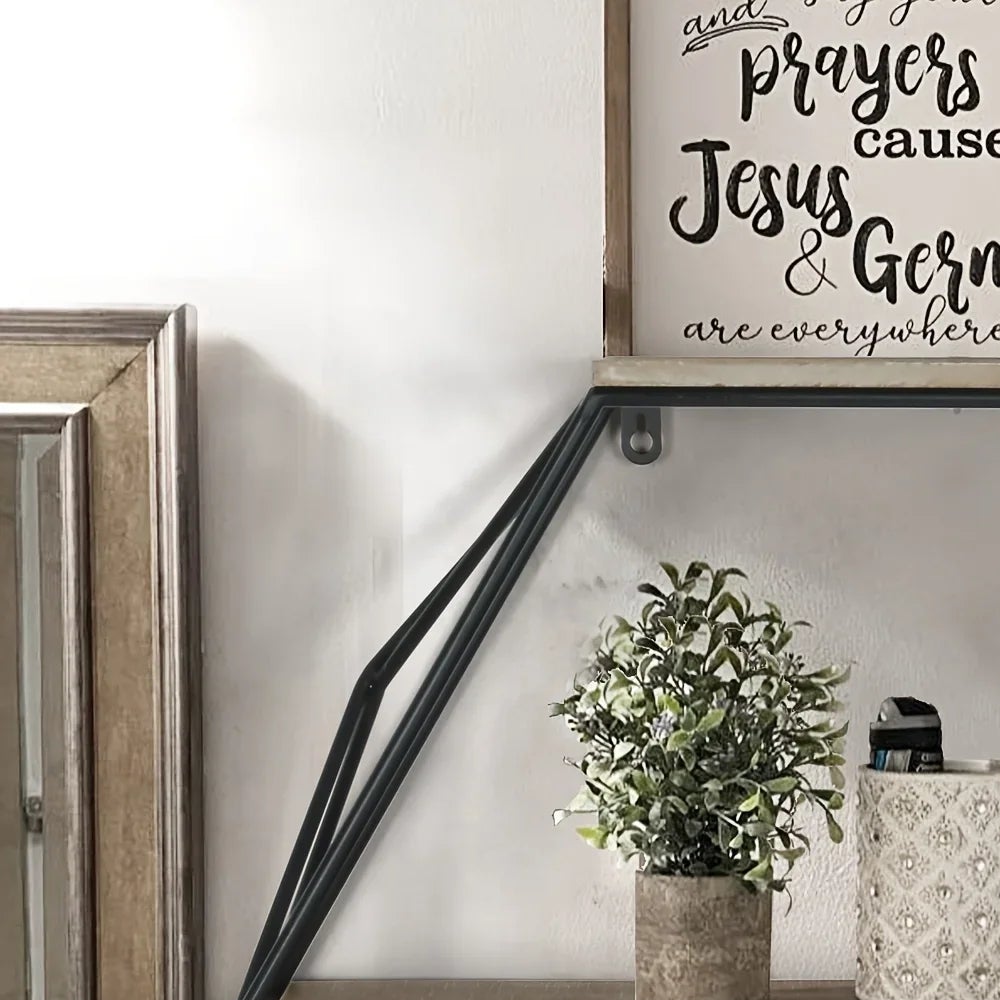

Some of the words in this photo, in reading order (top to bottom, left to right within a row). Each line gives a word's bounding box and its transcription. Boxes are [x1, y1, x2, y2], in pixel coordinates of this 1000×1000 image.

[741, 32, 980, 124] prayers
[669, 139, 852, 244] Jesus
[785, 228, 837, 296] &
[684, 318, 762, 343] are
